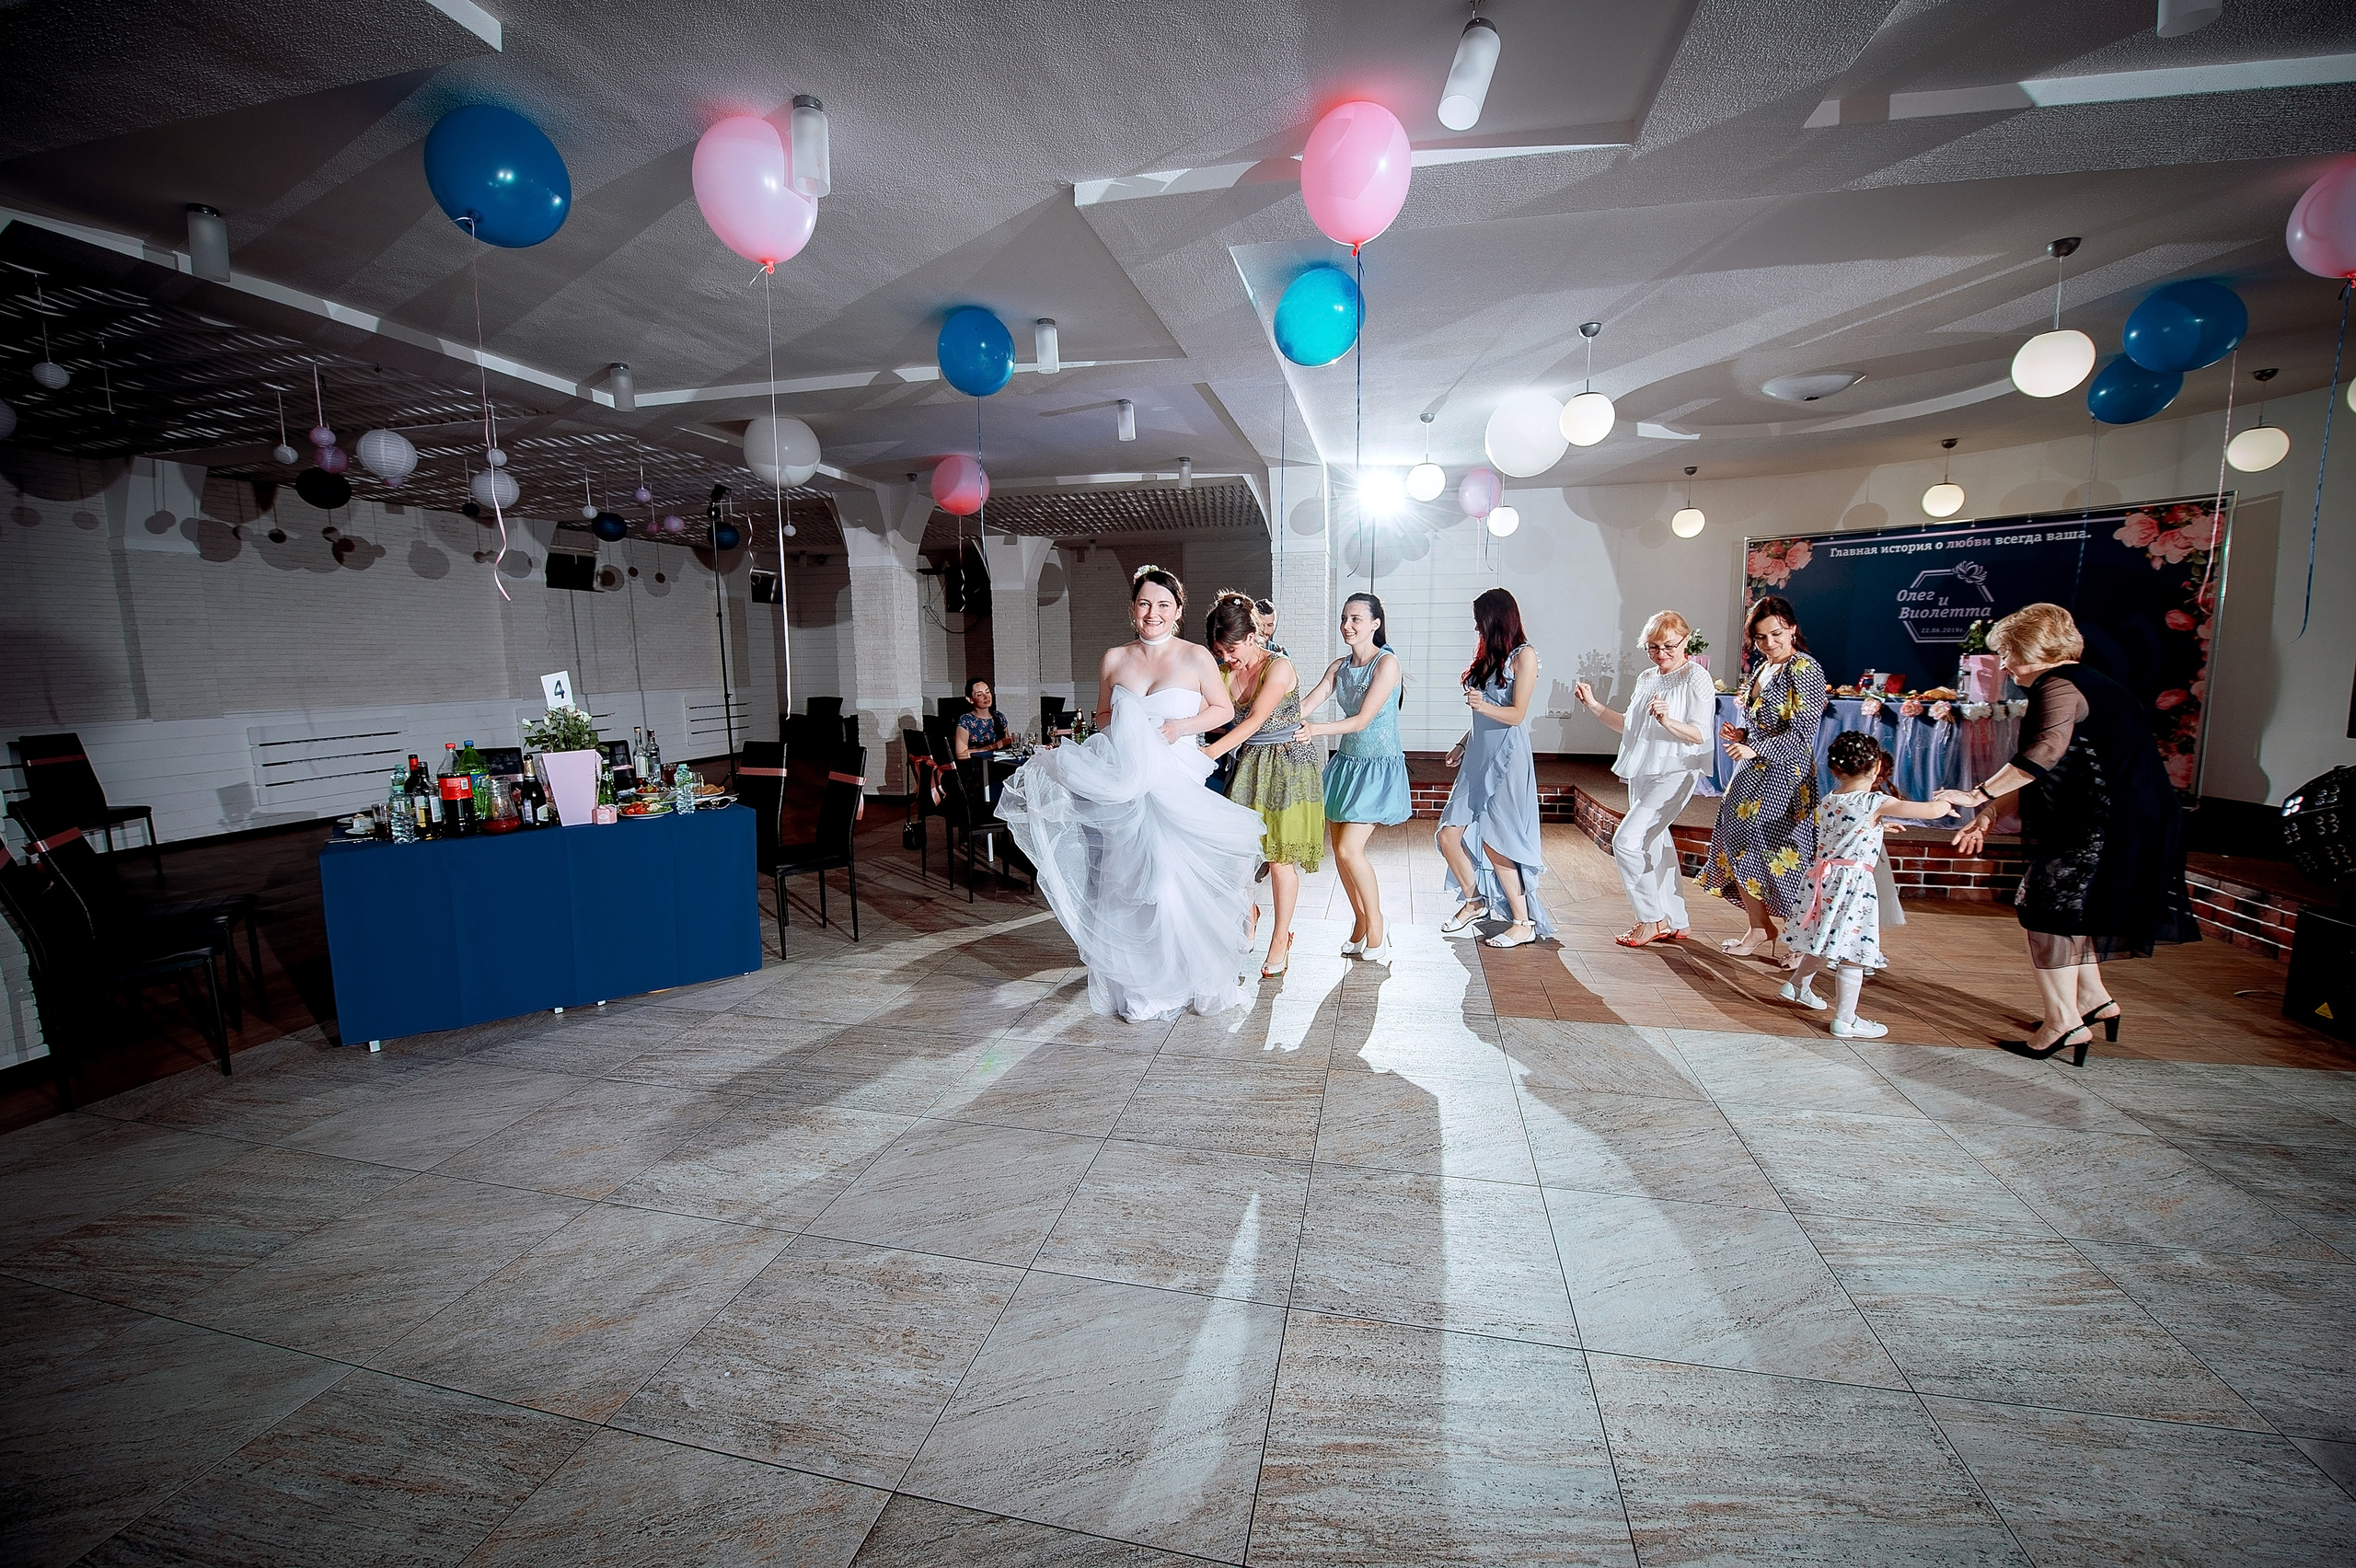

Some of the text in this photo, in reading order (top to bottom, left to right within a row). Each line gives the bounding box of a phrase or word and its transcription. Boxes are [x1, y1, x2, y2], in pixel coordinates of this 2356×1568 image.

[1830, 530, 2092, 558] Главная история о любви всегда ваша.
[1896, 589, 1949, 606] Олег и
[1898, 606, 1992, 619] Виолетта
[553, 679, 566, 699] 4
